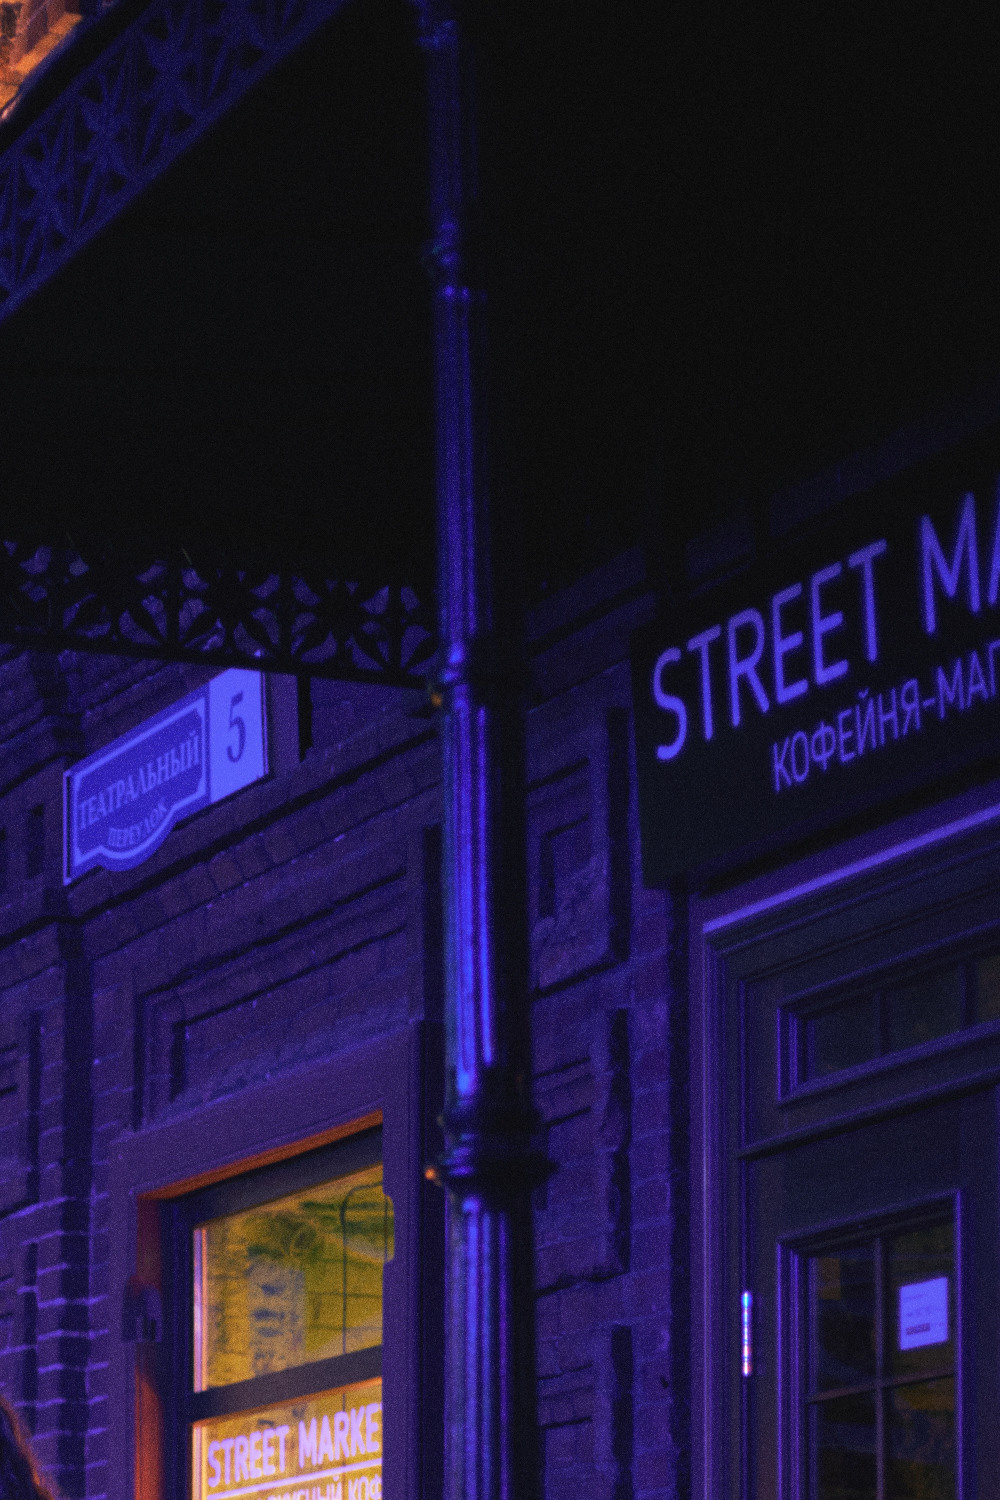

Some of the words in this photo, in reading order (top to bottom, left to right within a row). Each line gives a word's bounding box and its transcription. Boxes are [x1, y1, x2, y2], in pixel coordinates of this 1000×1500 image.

[652, 538, 889, 764] STREET
[916, 474, 1000, 639] M
[227, 693, 245, 763] 5
[80, 730, 199, 830] ТЕАТРАЛЬНЫЙ
[208, 1425, 290, 1488] STREET
[298, 1402, 382, 1469] MARKE
